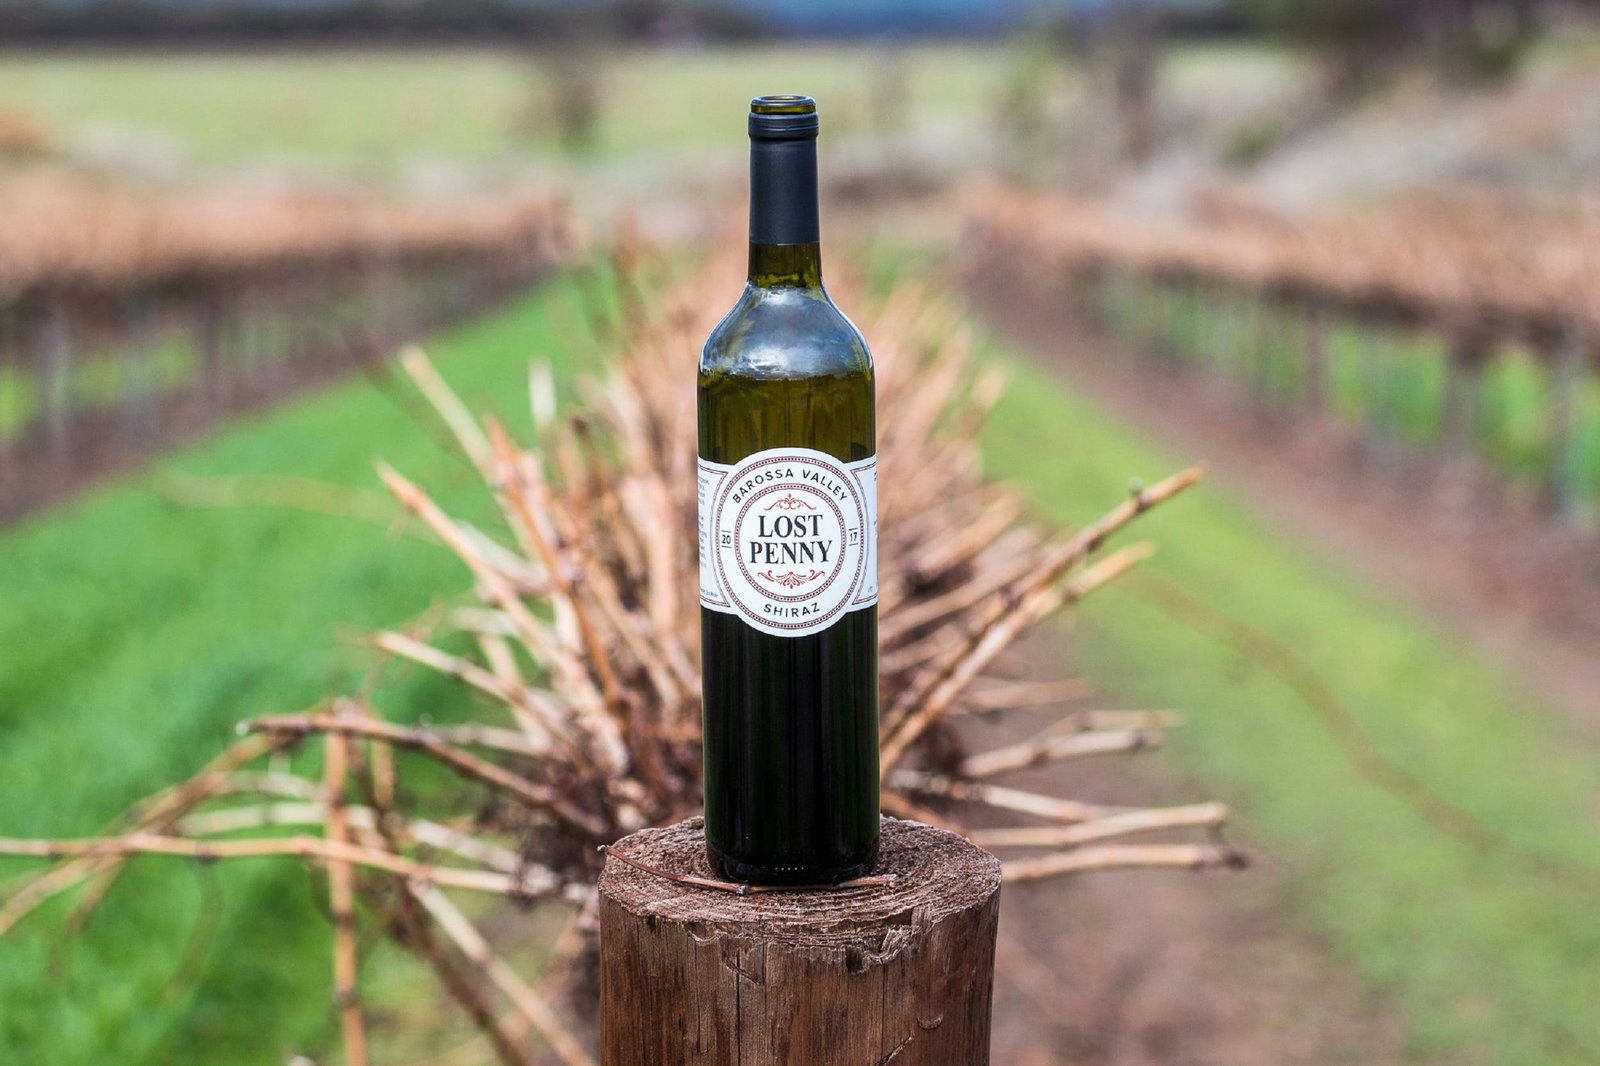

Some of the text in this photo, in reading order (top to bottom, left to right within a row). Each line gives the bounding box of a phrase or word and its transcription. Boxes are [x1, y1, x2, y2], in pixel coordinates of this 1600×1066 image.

[732, 468, 794, 504] BAROSSA
[802, 469, 848, 502] VALLEY
[758, 514, 823, 539] LOST
[849, 531, 858, 542] 17
[721, 534, 732, 545] 20
[749, 540, 833, 565] PENNY
[763, 602, 820, 618] SHIRAZ
